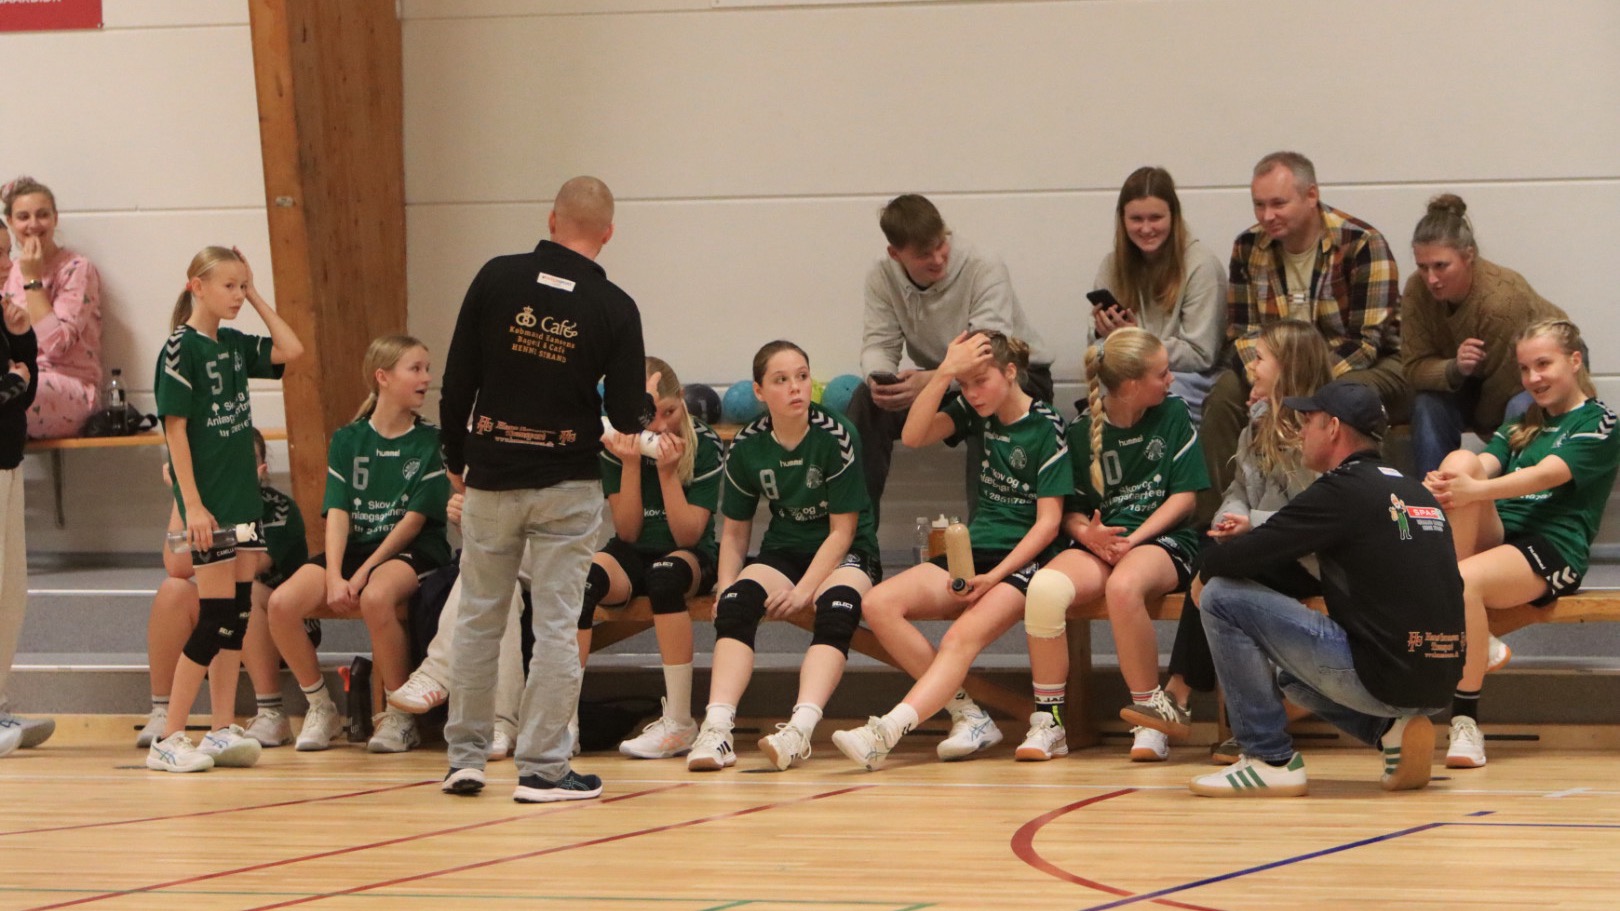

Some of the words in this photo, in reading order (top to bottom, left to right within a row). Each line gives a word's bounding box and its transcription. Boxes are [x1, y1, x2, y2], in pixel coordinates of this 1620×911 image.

[206, 361, 223, 395] 5
[1118, 434, 1144, 446] hummel
[376, 448, 401, 457] hummel
[780, 458, 803, 467] hummel
[353, 456, 370, 490] 6
[760, 469, 779, 500] 8
[1006, 477, 1020, 488] og
[368, 500, 391, 510] Skov
[643, 508, 660, 517] kov
[1413, 508, 1436, 517] SPAR
[831, 600, 854, 609] SELECT
